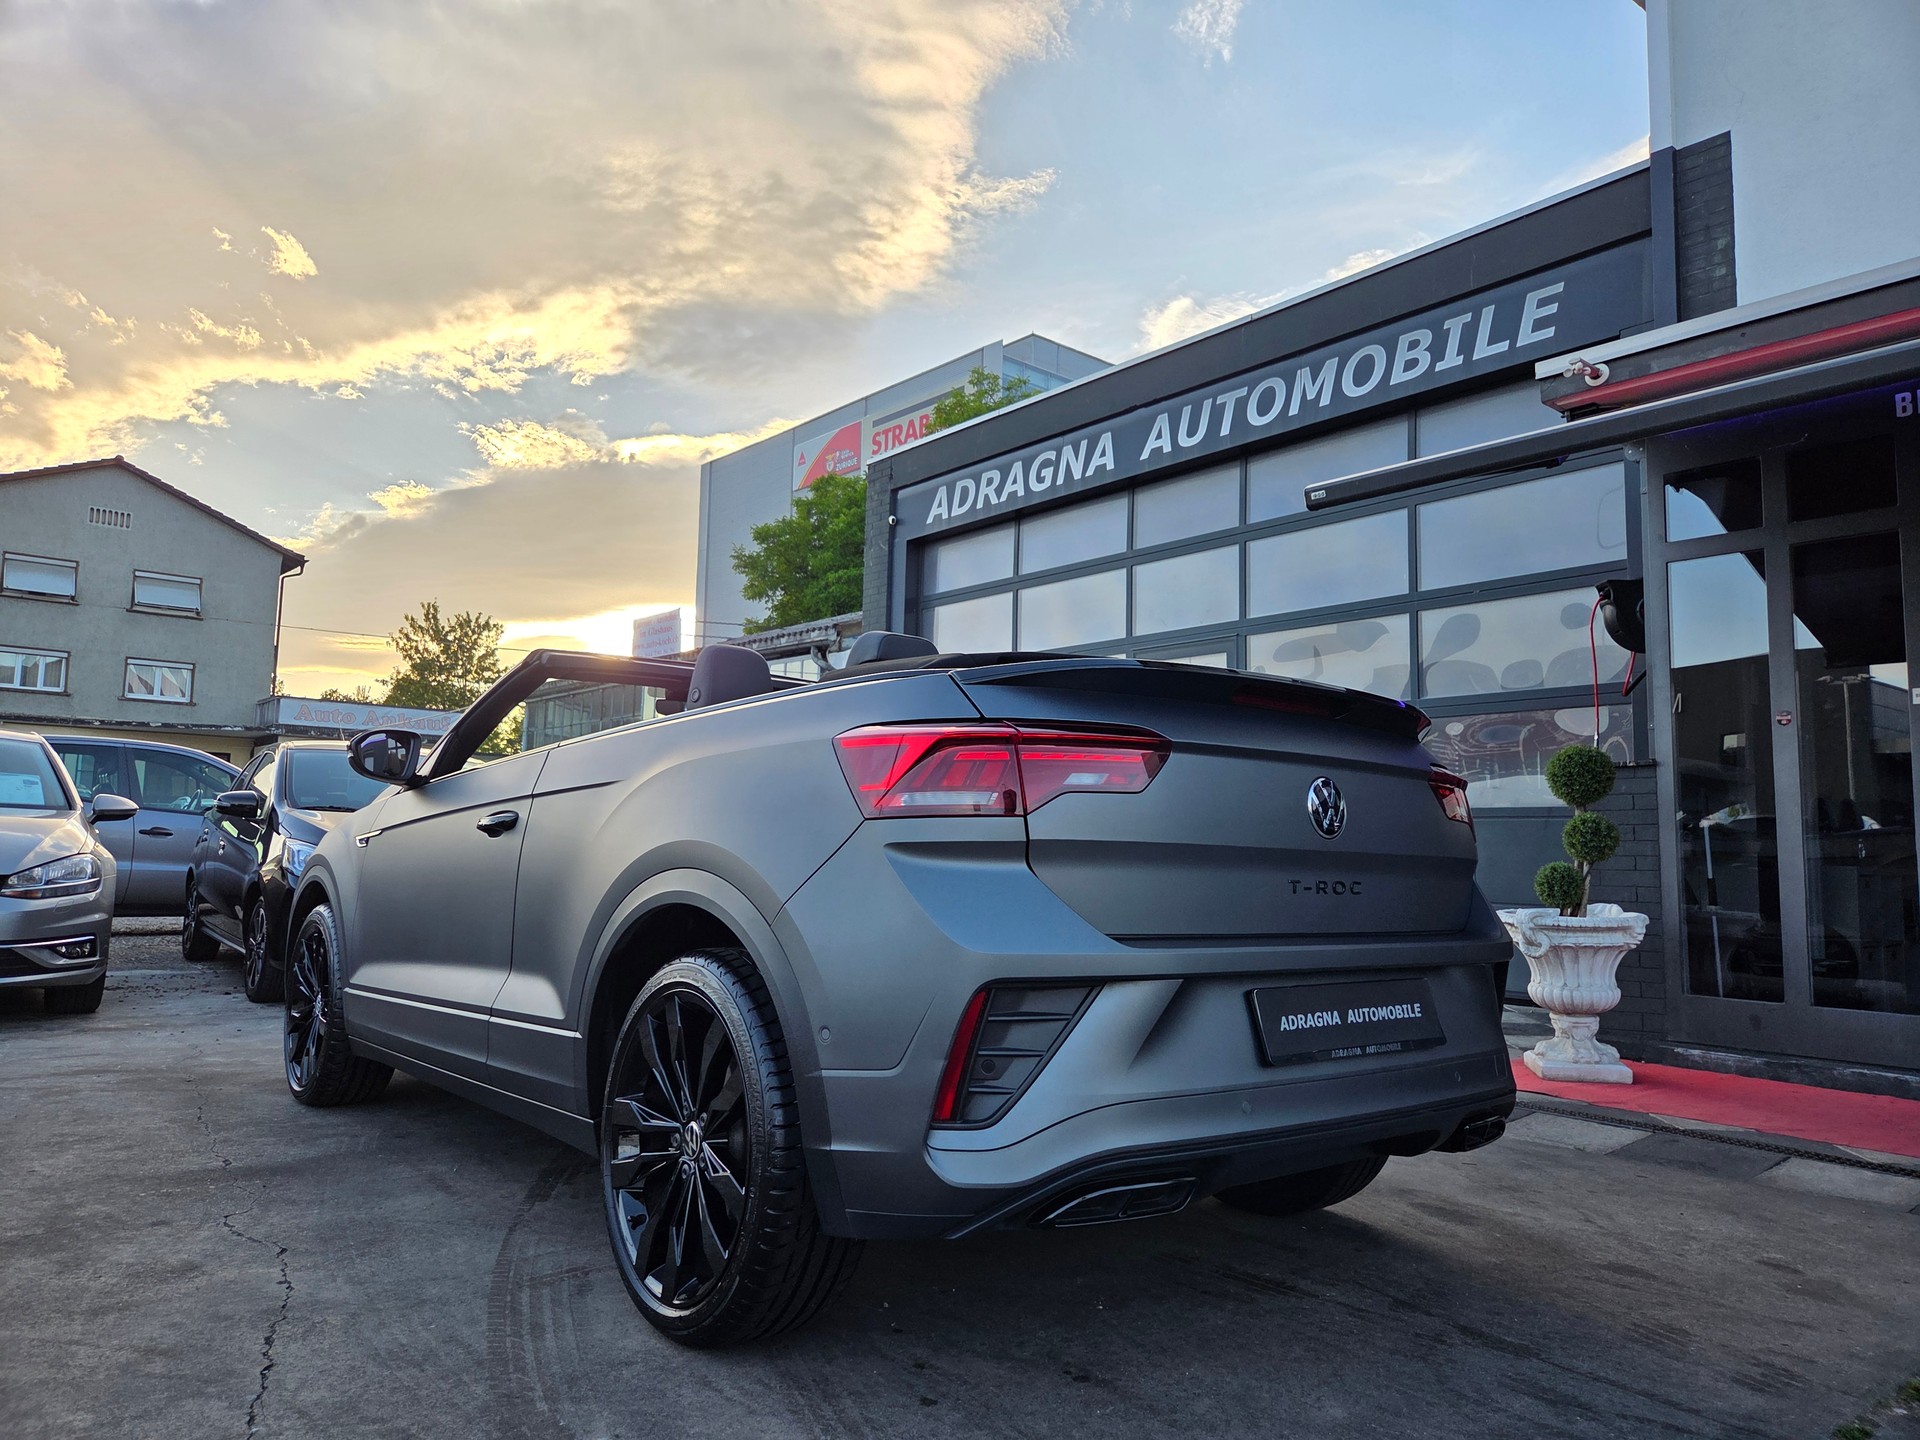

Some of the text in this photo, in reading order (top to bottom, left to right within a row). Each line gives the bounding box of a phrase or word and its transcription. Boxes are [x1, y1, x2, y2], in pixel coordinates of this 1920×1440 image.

[926, 281, 1565, 524] ADRAGNA AUTOMOBILE
[1895, 389, 1920, 417] B
[293, 704, 357, 725] Auto
[1287, 879, 1362, 895] T-ROC
[1280, 1003, 1422, 1032] ADRAGNA AUTOMOBILE
[1331, 1047, 1362, 1058] ADRAGNA
